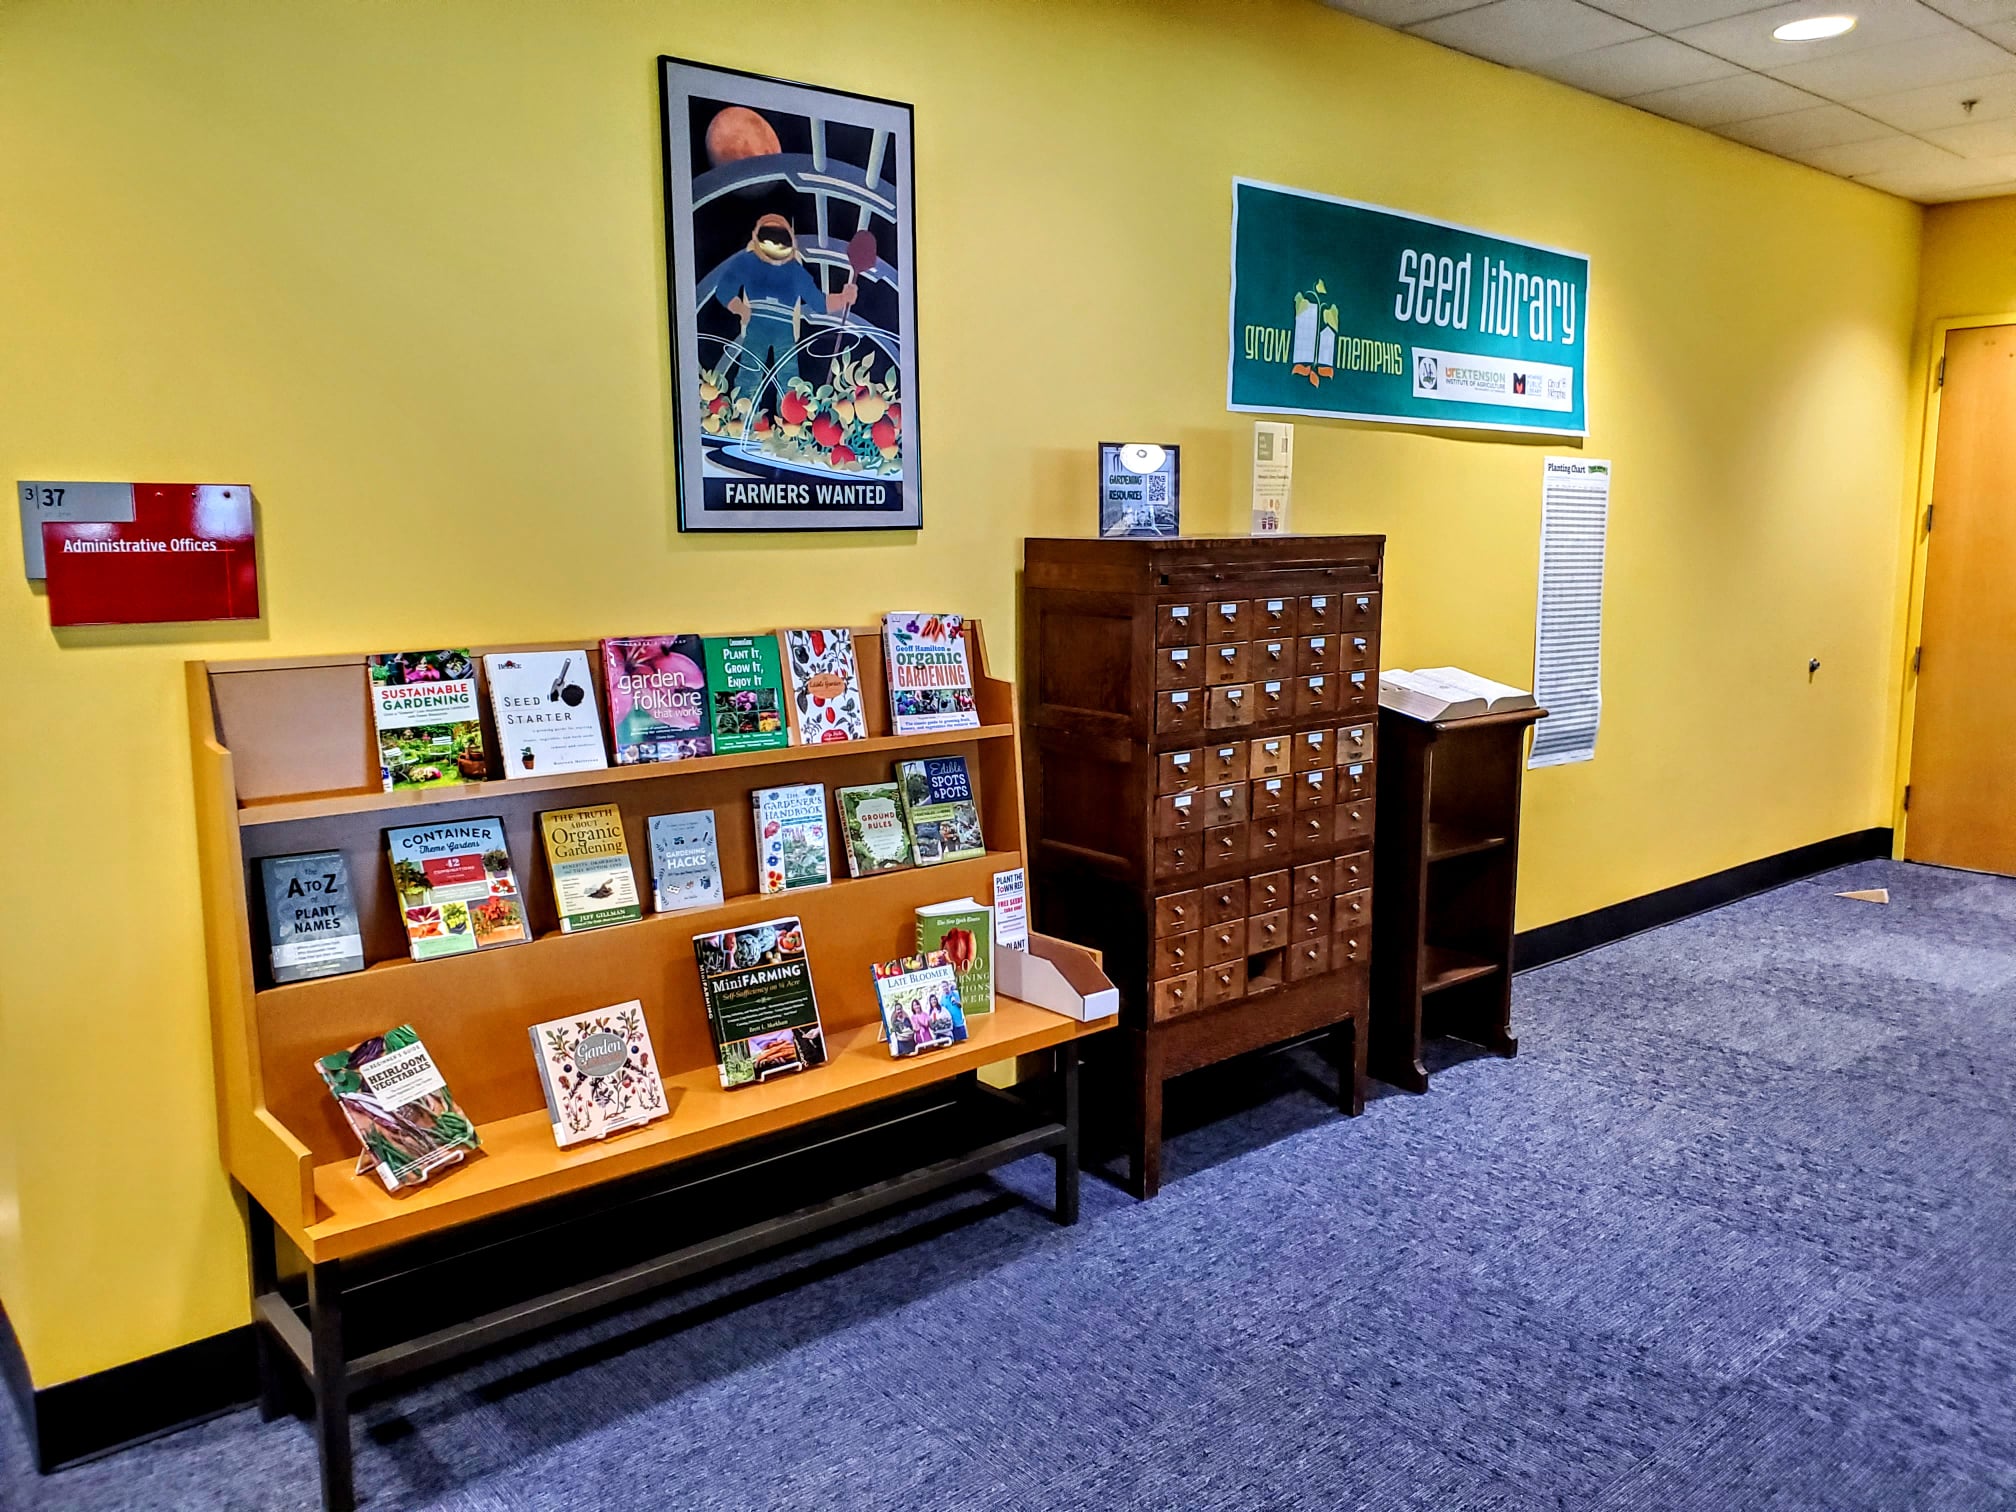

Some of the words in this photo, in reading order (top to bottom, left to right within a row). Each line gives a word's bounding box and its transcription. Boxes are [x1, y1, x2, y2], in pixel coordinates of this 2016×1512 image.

[1394, 249, 1471, 330] seed
[1479, 257, 1575, 345] library
[1245, 325, 1291, 363] grow
[1548, 463, 1570, 474] Planting
[1571, 465, 1585, 473] Chart
[1109, 475, 1142, 485] GARDENING
[25, 488, 34, 500] 3
[42, 489, 65, 506] 37
[725, 484, 809, 504] FARMERS
[816, 485, 886, 505] WANTED
[1109, 490, 1142, 500] RESOURCES
[63, 539, 167, 552] Administrative
[170, 538, 217, 551] Offices
[896, 648, 962, 670] organic
[618, 669, 686, 694] garden
[897, 664, 967, 687] GARDENING
[381, 683, 468, 699] SUSTAINABLE
[383, 693, 469, 710] GARDENING
[504, 696, 540, 707] SEED
[632, 689, 702, 711] folklore
[507, 712, 572, 725] STARTER
[654, 708, 672, 719] that
[675, 706, 703, 718] works
[929, 762, 962, 776] Edible
[931, 774, 966, 787] SPOTS
[940, 786, 969, 799] POTS
[764, 797, 822, 811] GARDENER'S
[552, 813, 575, 823] THE
[577, 809, 613, 820] TRUTH
[765, 806, 822, 820] HANDBOOK
[862, 812, 895, 822] GROUND
[571, 819, 599, 829] ABOUT
[868, 821, 893, 829] RULES
[402, 828, 492, 848] CONTAINER
[552, 822, 621, 847] Organic
[420, 844, 445, 854] Theme
[446, 840, 480, 853] Gardens
[555, 840, 623, 858] Gardening
[666, 847, 706, 858] GARDENING
[667, 855, 707, 870] HACKS
[287, 878, 305, 898] A
[304, 880, 322, 892] TO
[322, 873, 338, 893] Z
[996, 875, 1013, 886] PLANT
[1014, 872, 1022, 881] THE
[1014, 881, 1023, 890] RED
[295, 905, 337, 920] PLANT
[580, 913, 594, 922] JEFF
[596, 908, 626, 919] GILLMAN
[294, 918, 341, 934] NAMES
[712, 964, 801, 993] MiniFARMING
[888, 977, 908, 988] LATE
[909, 968, 949, 983] BLOOMER
[577, 1038, 621, 1065] Garden
[367, 1053, 427, 1085] HEIRLOOM
[372, 1061, 431, 1092] VEGETABLES
